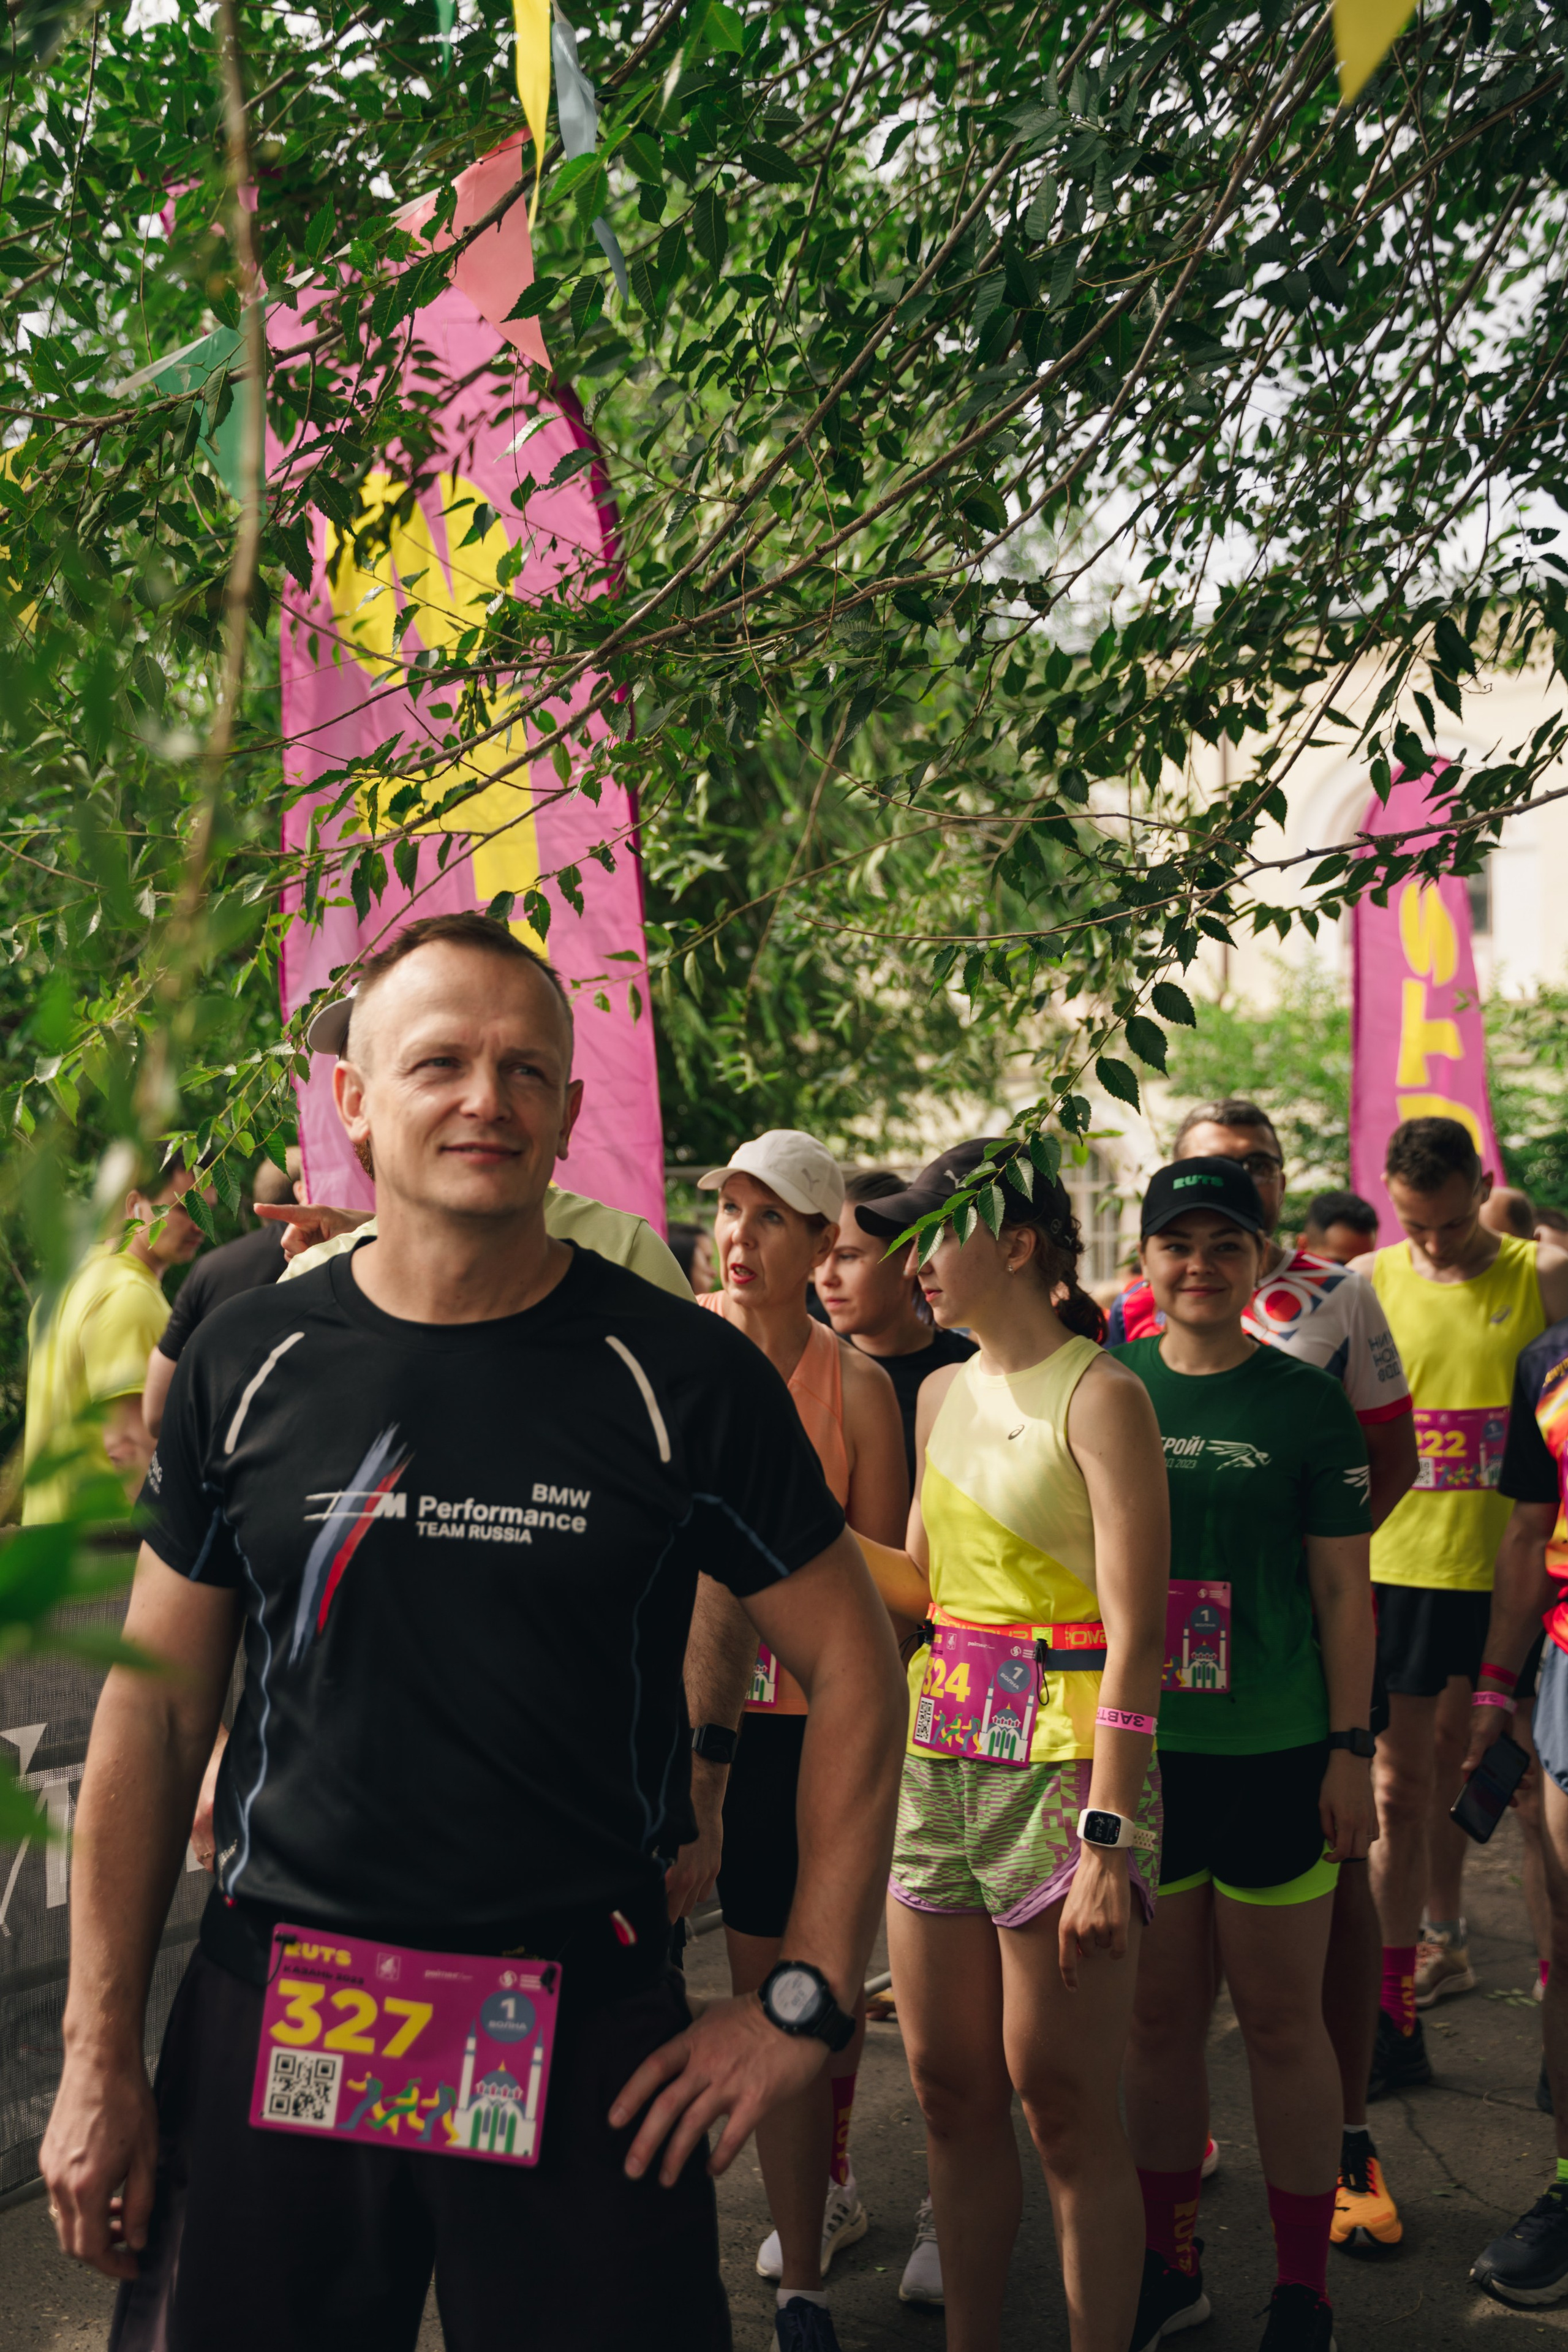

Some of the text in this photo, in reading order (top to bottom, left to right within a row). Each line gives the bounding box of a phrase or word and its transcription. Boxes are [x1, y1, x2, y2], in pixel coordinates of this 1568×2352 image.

[1173, 1174, 1224, 1189] RUTS
[1175, 1458, 1197, 1469] 2023
[532, 1483, 590, 1509] BMW
[419, 1495, 587, 1533] Performance
[417, 1521, 532, 1544] TEAM RUSSIA
[1200, 1610, 1210, 1622] 1
[922, 1657, 971, 1703] 324
[999, 1673, 1020, 1691] ВОЛНА
[1012, 1666, 1024, 1680] 1
[285, 1942, 352, 1966] RUTS
[283, 1964, 333, 1980] КАЗАНЬ
[500, 1997, 516, 2020] 1
[269, 1979, 434, 2059] 327
[488, 2019, 528, 2031] ВОЛНА
